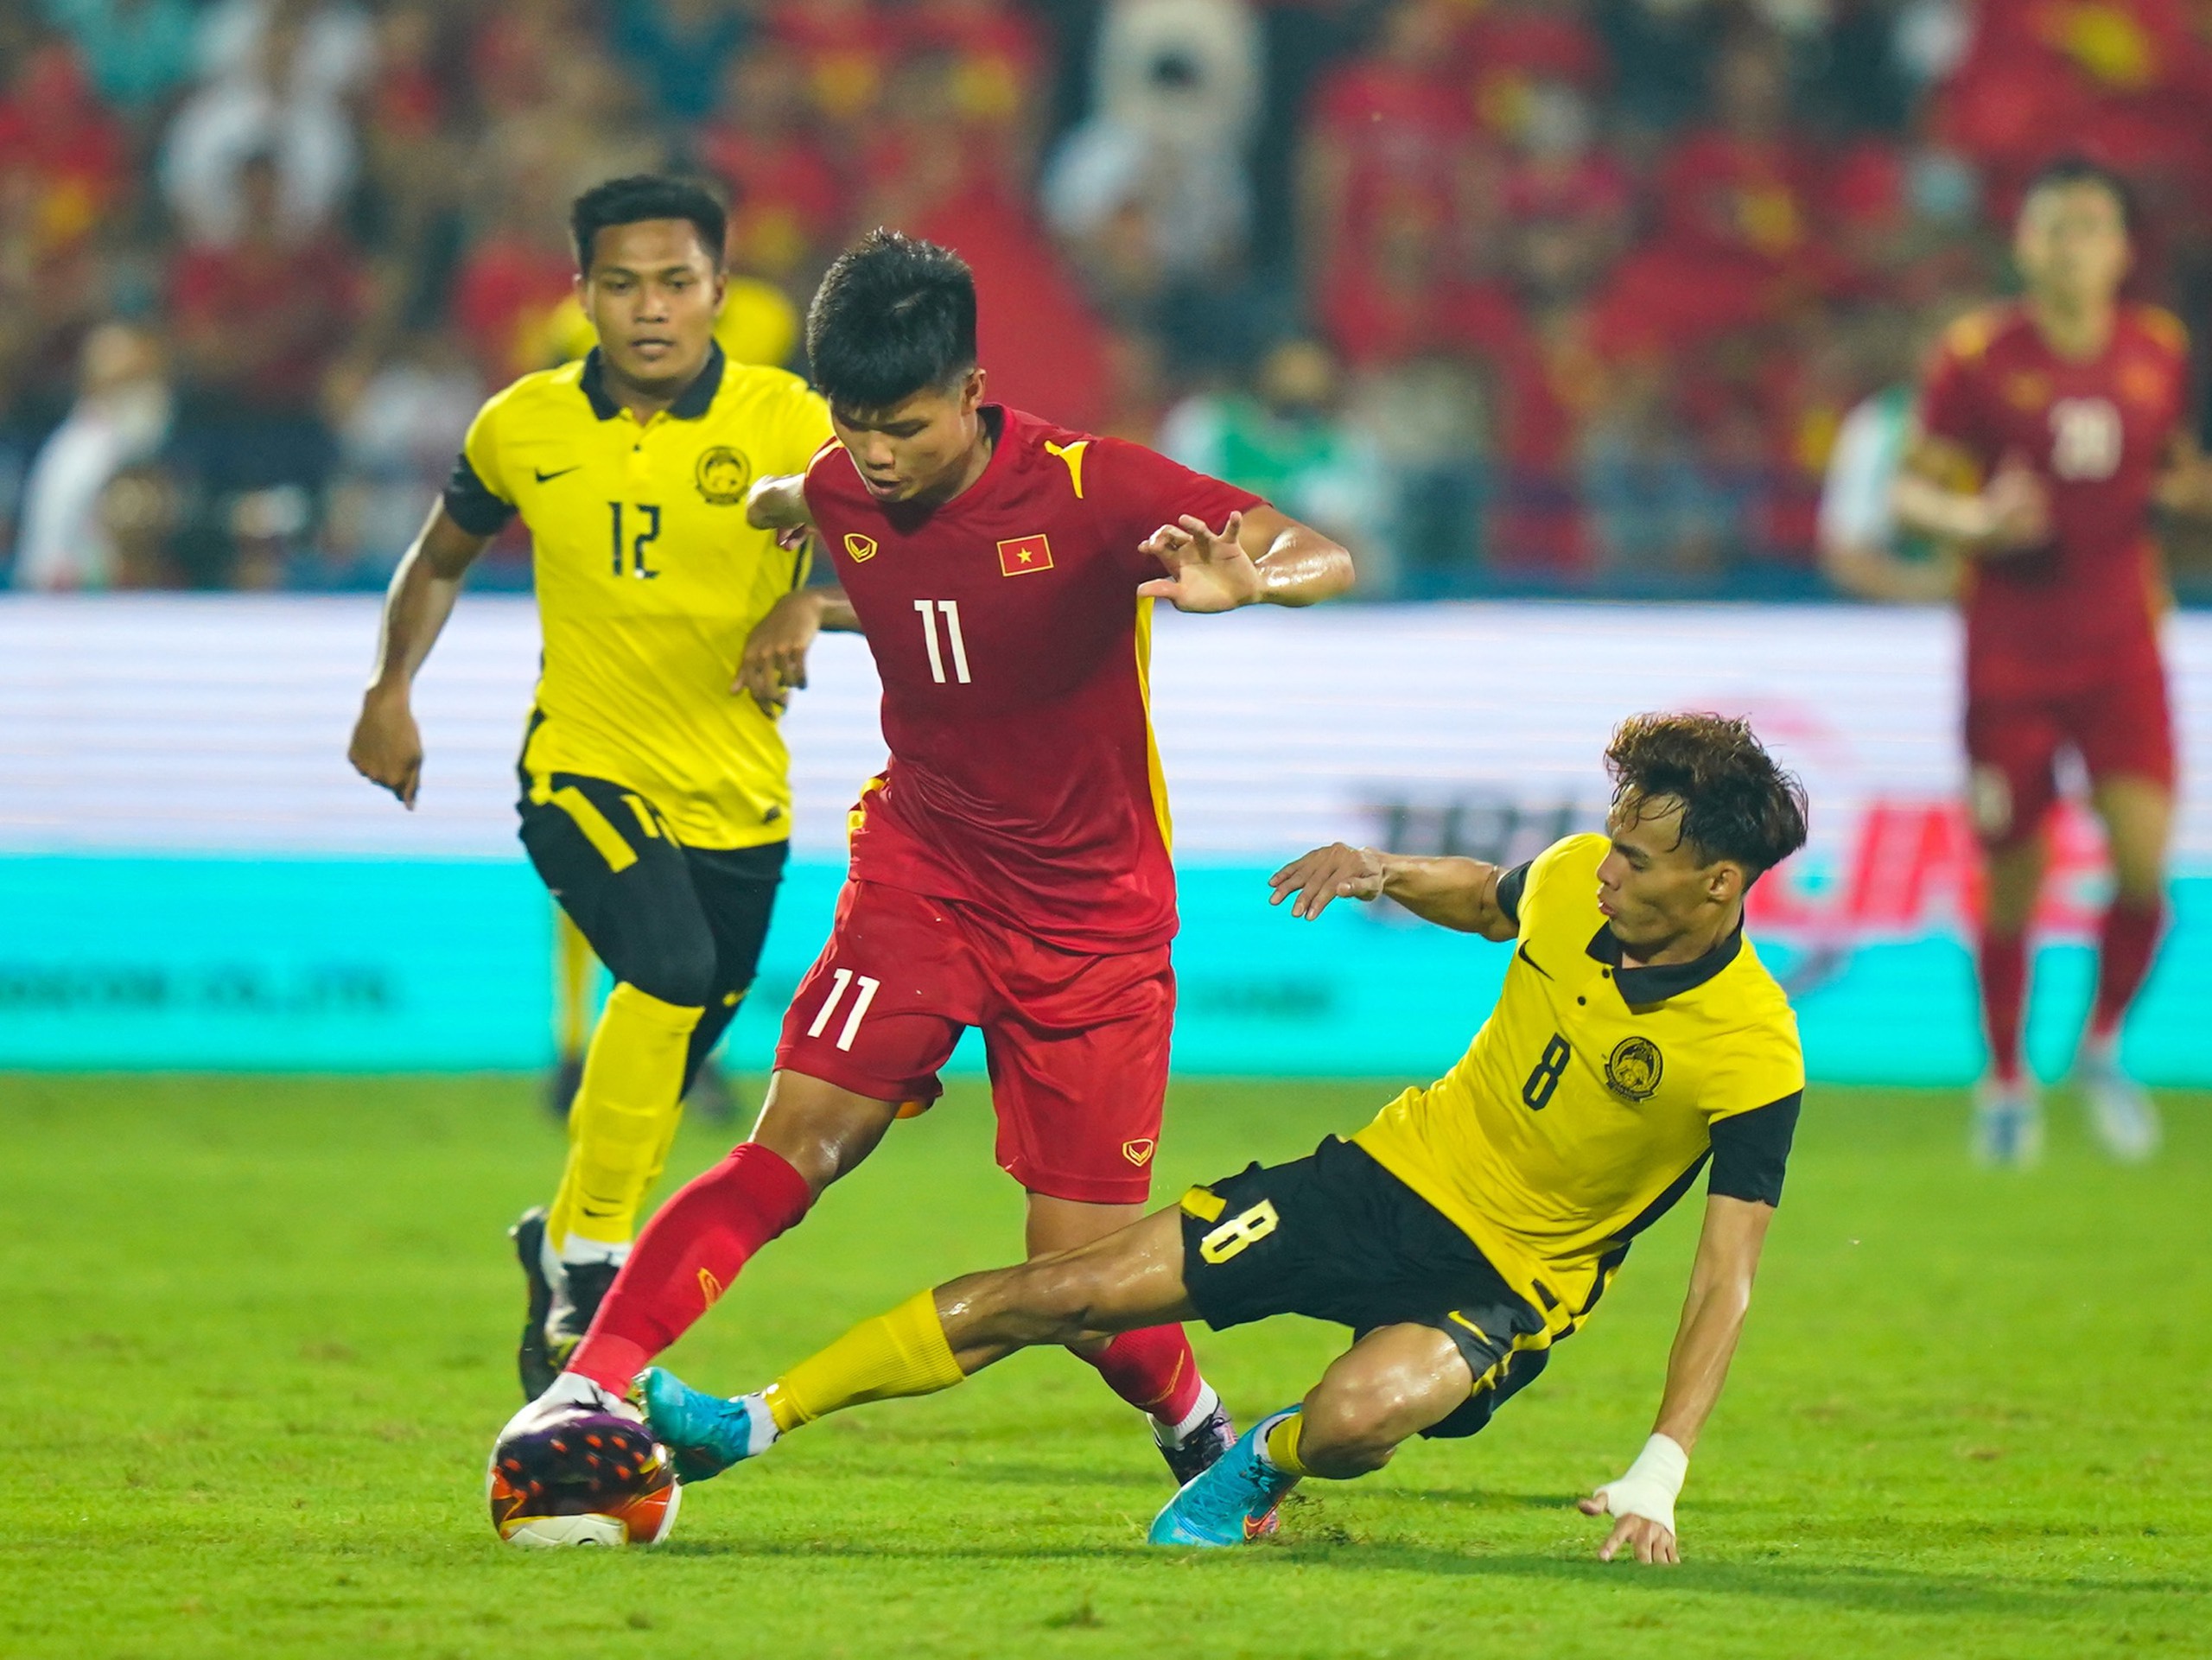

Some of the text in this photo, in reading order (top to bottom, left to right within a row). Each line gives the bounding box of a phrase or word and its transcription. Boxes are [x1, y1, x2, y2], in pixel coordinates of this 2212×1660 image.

[608, 501, 661, 579] 12
[913, 599, 971, 684] 11
[806, 967, 880, 1052] 11
[1522, 1032, 1571, 1111] 8
[1198, 1198, 1280, 1264] 8
